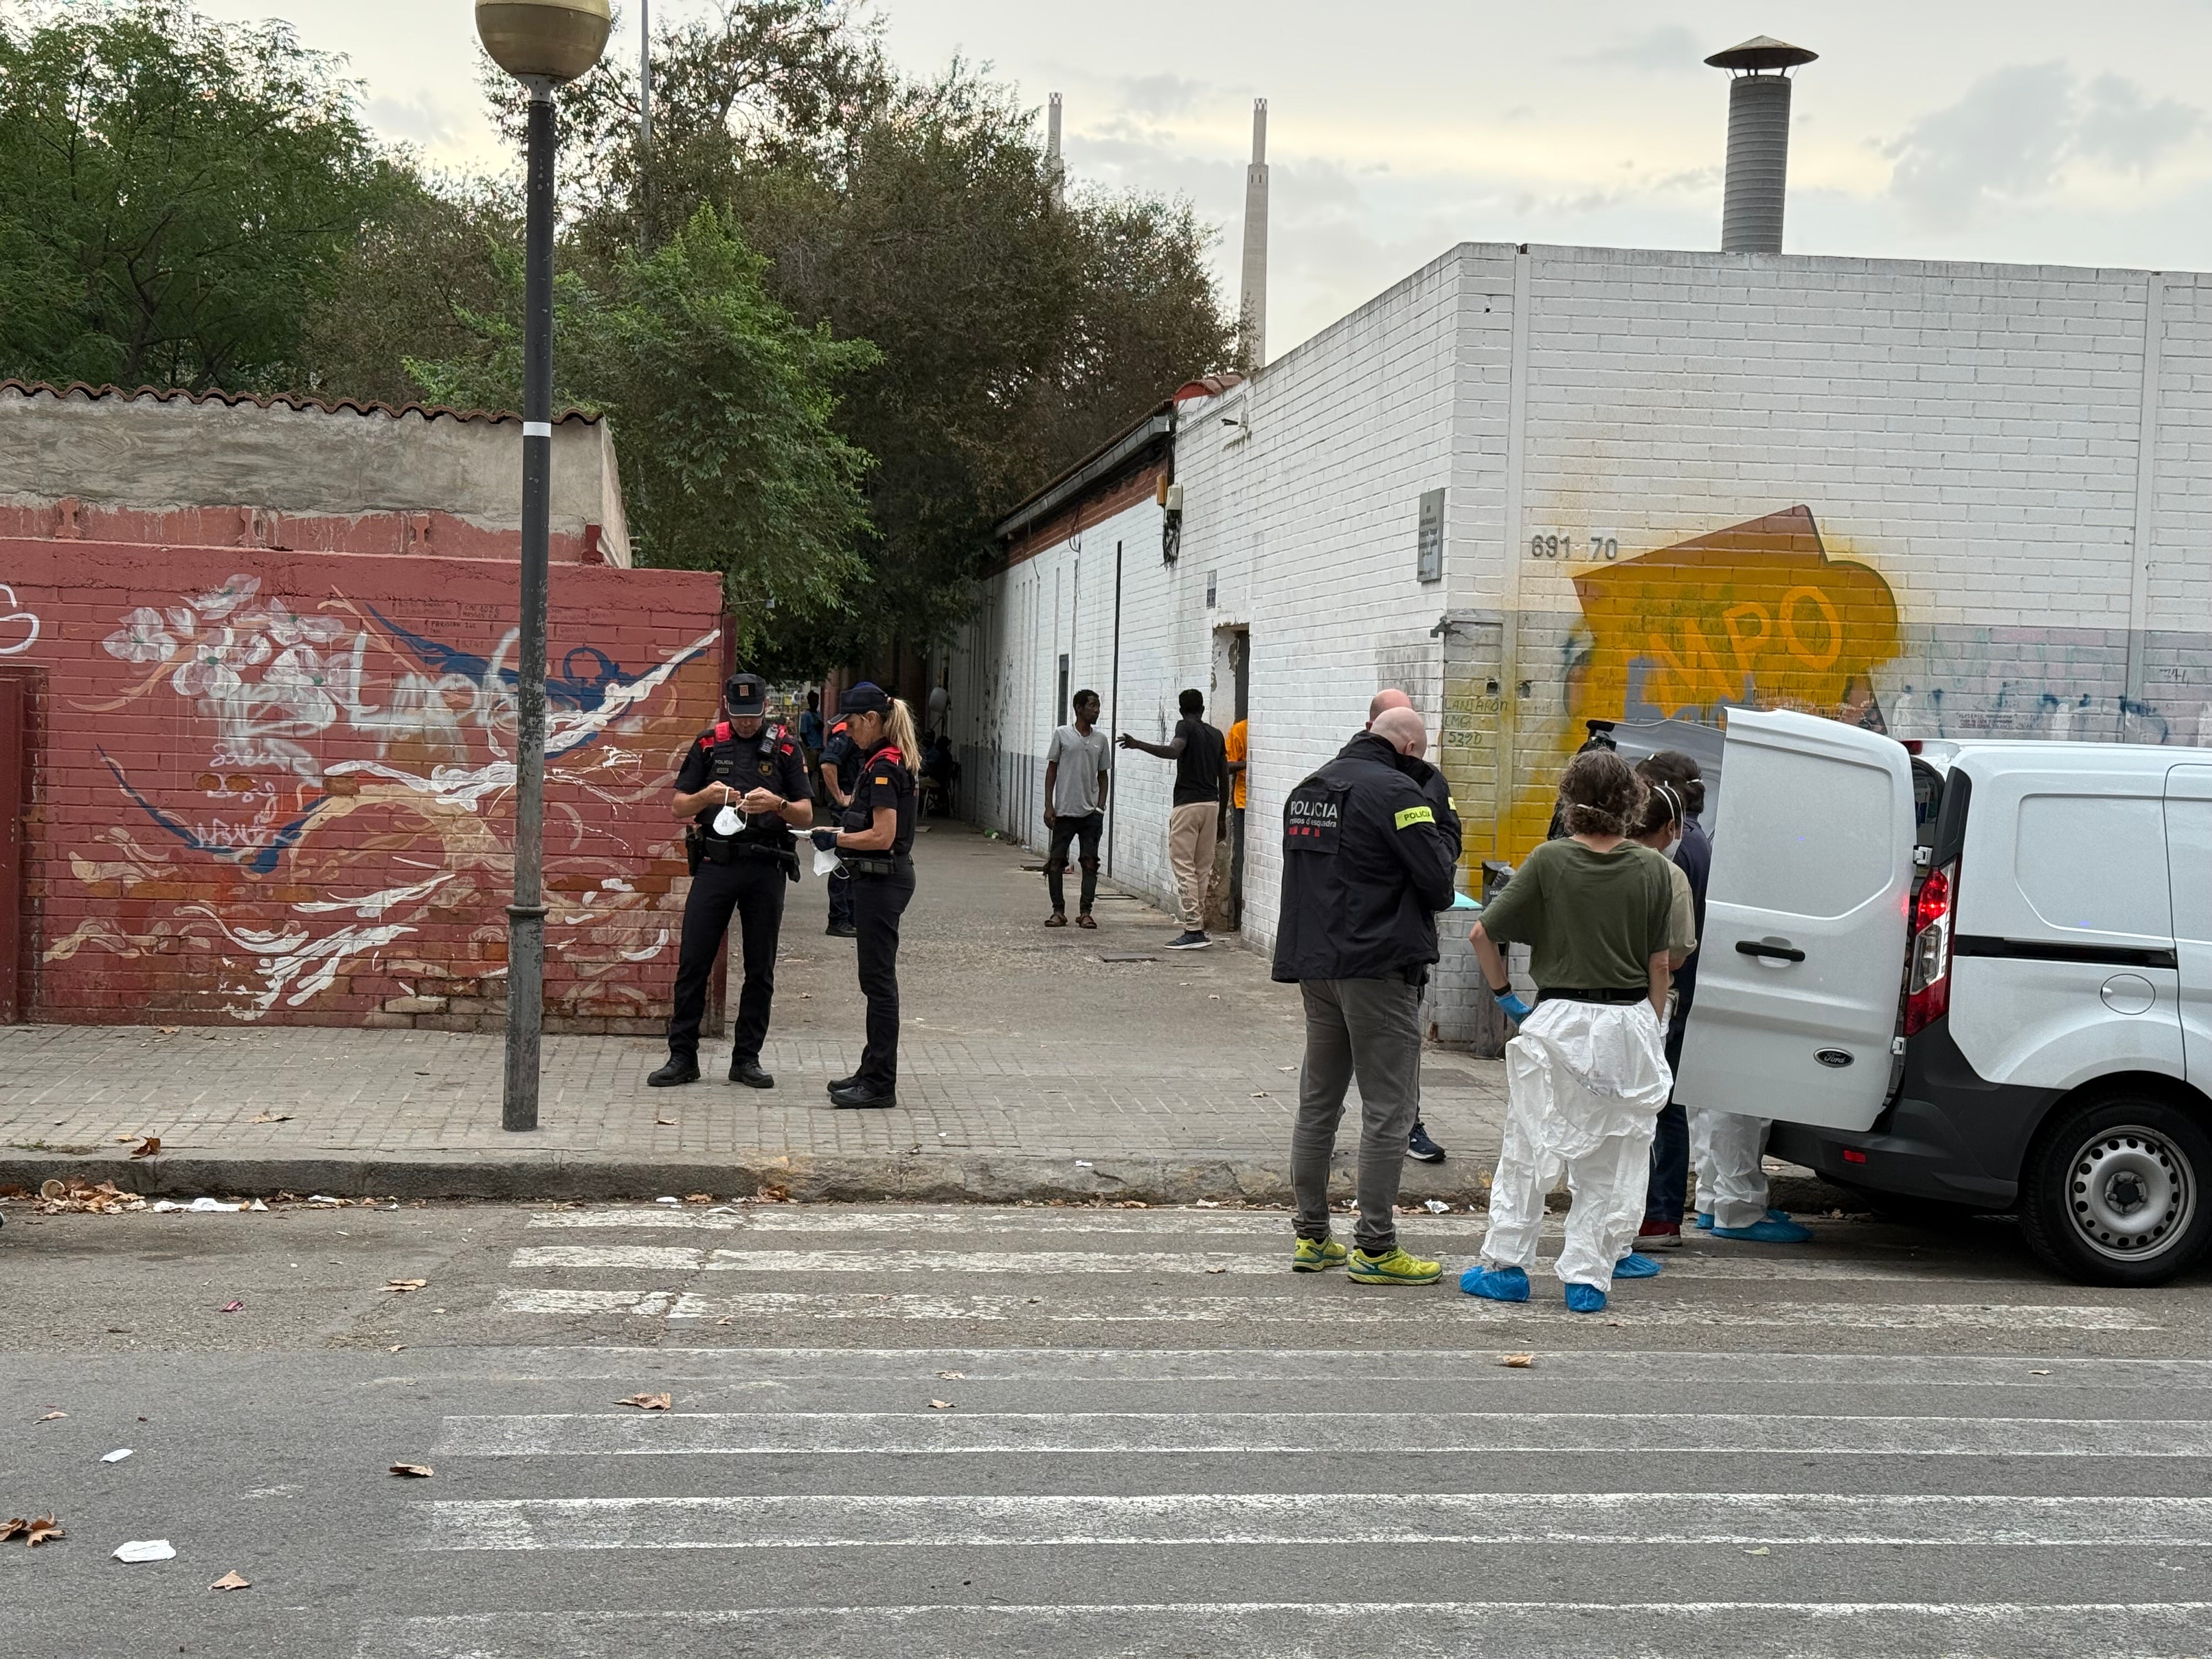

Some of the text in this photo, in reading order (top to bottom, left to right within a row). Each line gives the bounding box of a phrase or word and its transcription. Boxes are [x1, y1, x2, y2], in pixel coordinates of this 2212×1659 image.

[1531, 534, 1618, 560] 691 70
[1290, 800, 1338, 819] POLICIA
[1824, 1052, 1846, 1063] Ford
